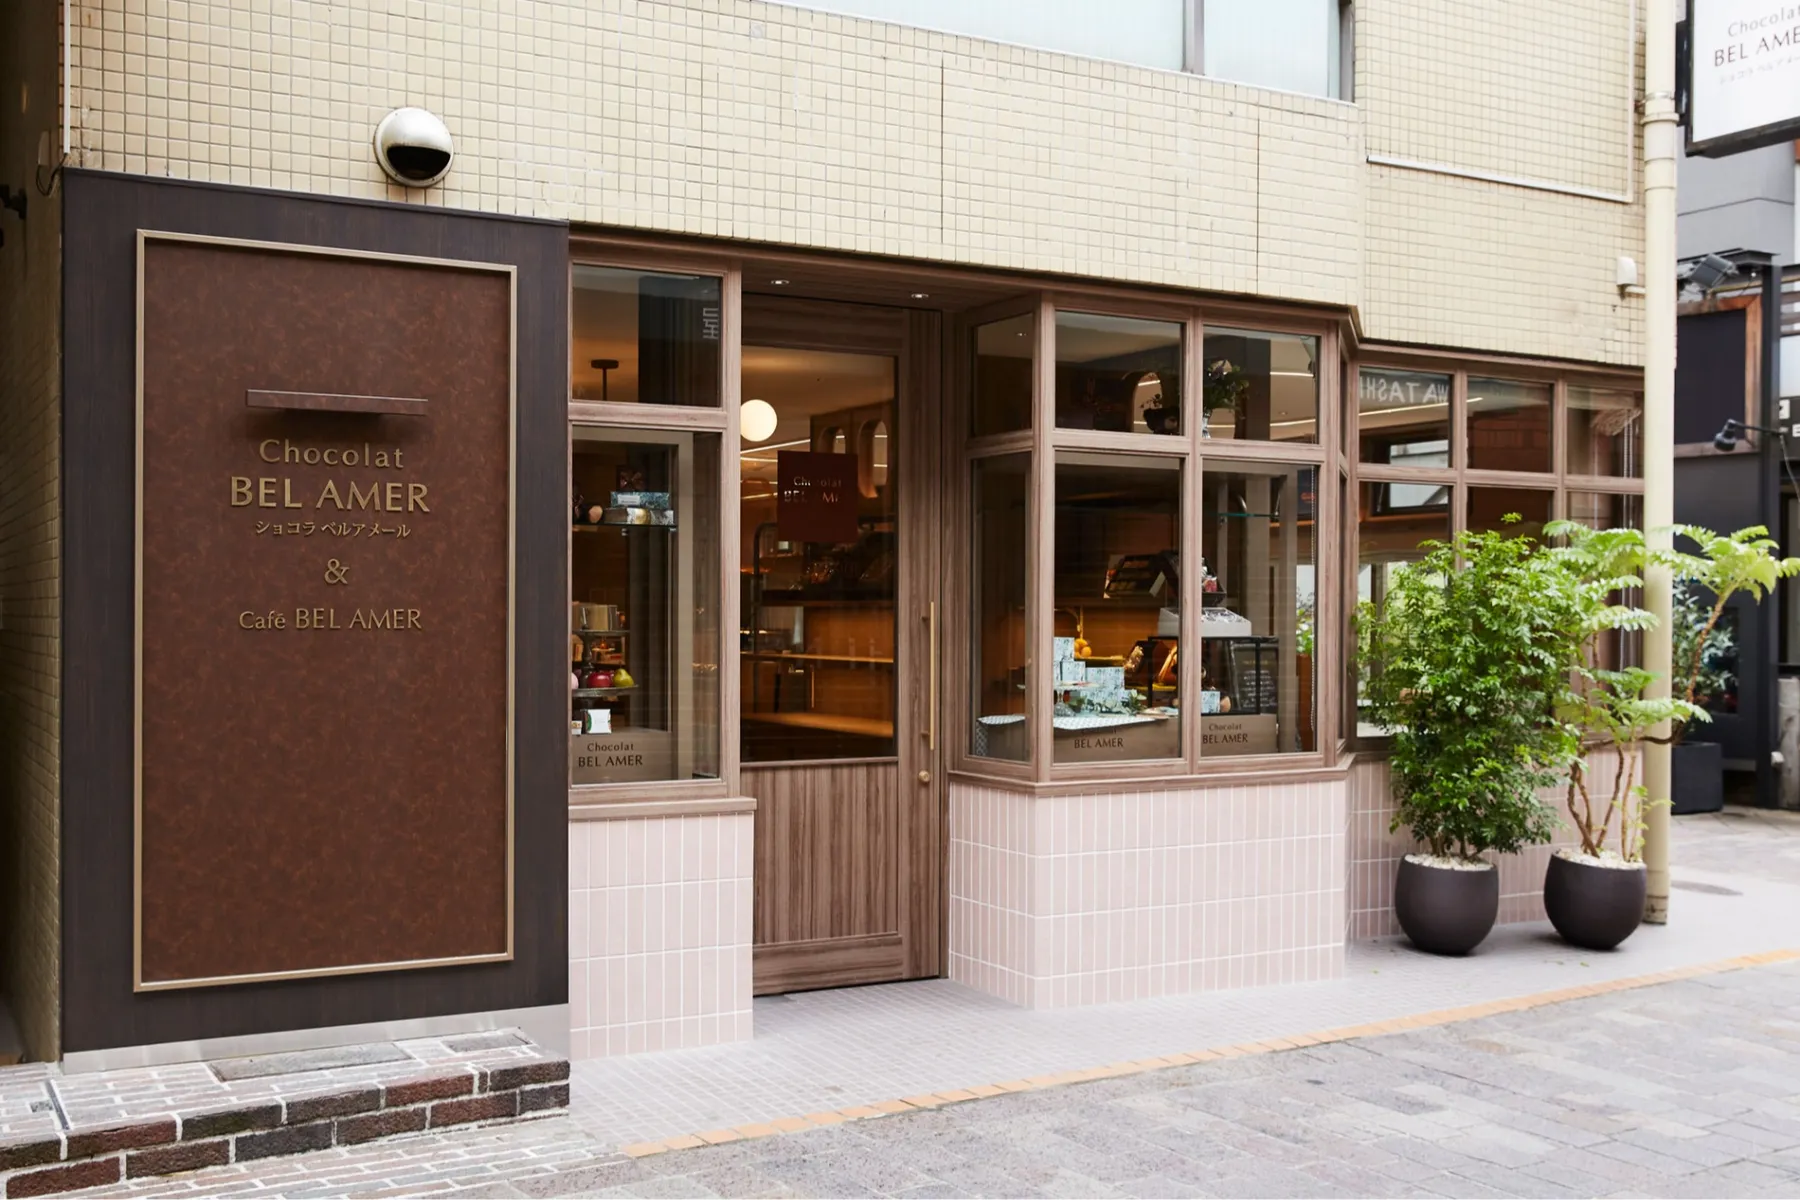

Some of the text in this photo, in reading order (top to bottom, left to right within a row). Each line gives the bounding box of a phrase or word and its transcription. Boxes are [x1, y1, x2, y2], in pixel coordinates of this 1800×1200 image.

[1714, 42, 1749, 67] BEL
[259, 438, 404, 469] Chocolat
[231, 476, 431, 513] BEL AMER
[255, 521, 412, 539] ショコラ ベルアメール
[324, 558, 350, 585] &
[239, 607, 422, 630] Café BEL AMER
[1208, 723, 1242, 731] Chocolat
[587, 742, 634, 752] Chocolat
[1074, 737, 1123, 749] BEL AMER
[1202, 733, 1249, 744] BEL AMER
[578, 755, 643, 767] BEL AMER
